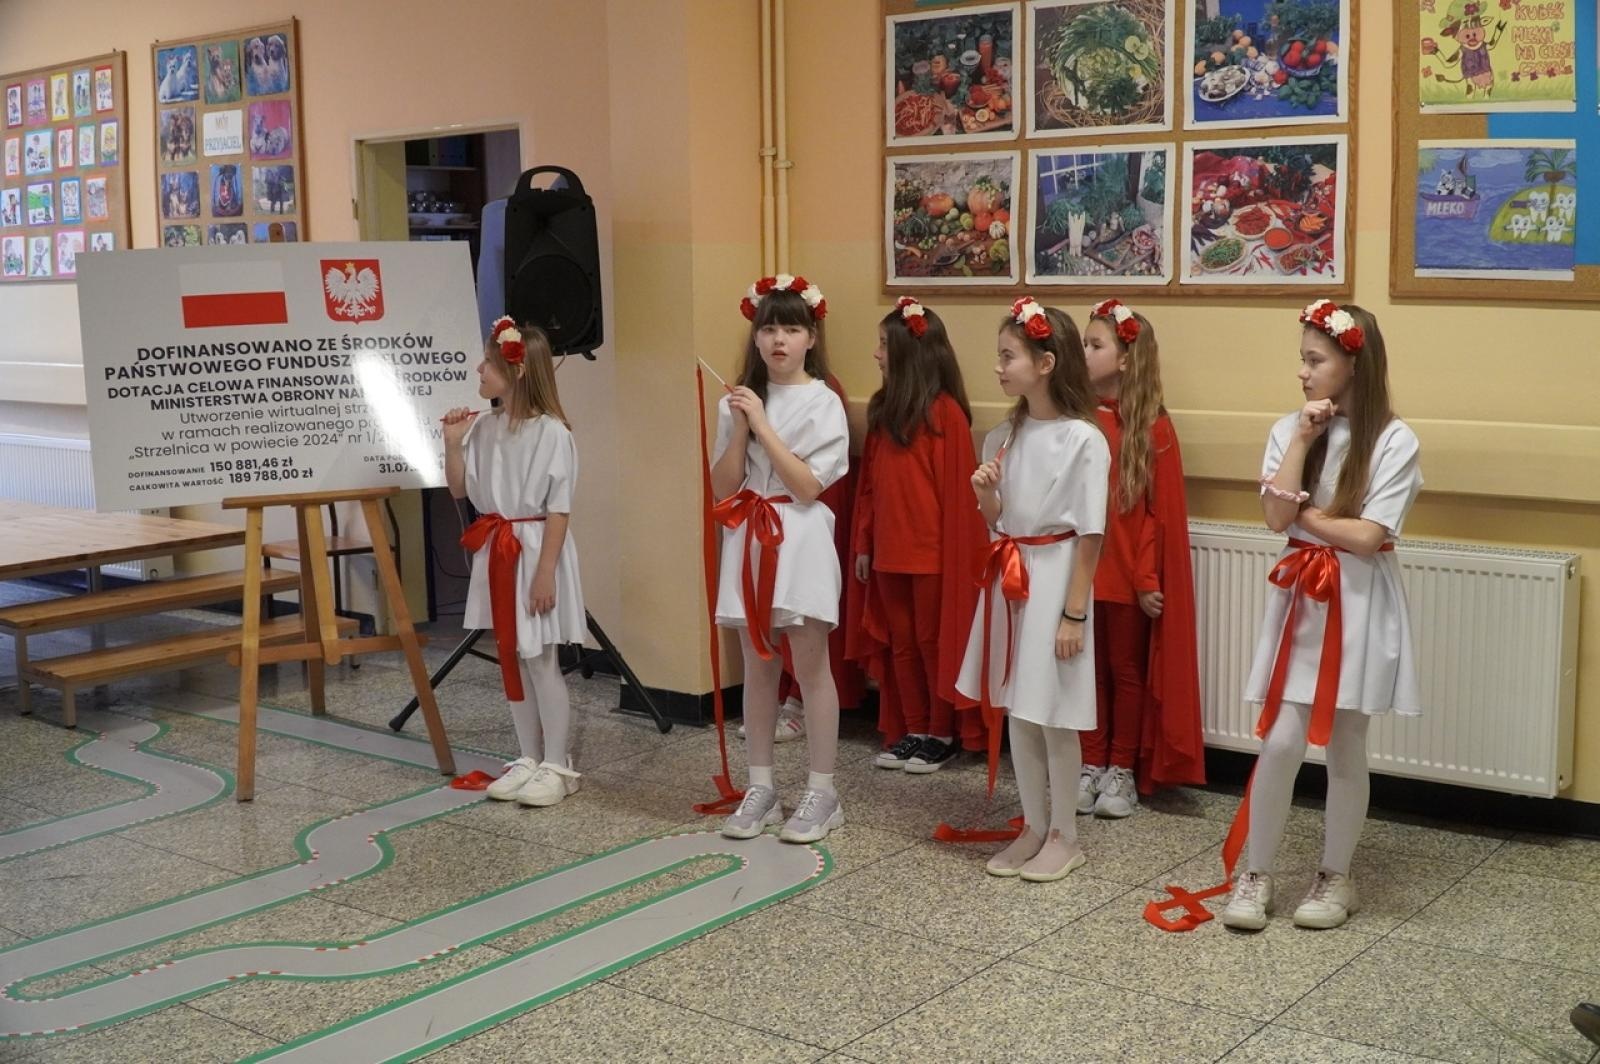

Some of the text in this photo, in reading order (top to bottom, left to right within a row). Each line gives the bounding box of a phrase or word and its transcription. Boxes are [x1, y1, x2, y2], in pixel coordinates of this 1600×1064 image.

[1427, 201, 1465, 216] MLEKO
[137, 332, 433, 361] DOFINANSOWANO ZE ŚRODKÓW
[105, 357, 262, 381] PAŃSTWOWEGO
[267, 354, 354, 370] FUNDUSZ
[108, 383, 184, 399] DOTACJA
[187, 379, 254, 394] CELOWA
[151, 392, 268, 411] MINISTERSTWA
[271, 388, 335, 402] OBRONY
[180, 408, 264, 425] Utworzenie
[268, 404, 341, 419] wirtualnej
[161, 431, 175, 441] w
[179, 425, 241, 440] ramach
[244, 420, 354, 436] realizowanego
[213, 442, 226, 452] w
[230, 434, 299, 454] powiecie
[348, 433, 362, 444] nr
[128, 456, 293, 479] DOFINANSOWANIE 150 881,46 zł
[363, 455, 385, 463] DATA
[129, 467, 314, 492] CAŁKOWITA WARTOŚĆ 189 788,00 zł
